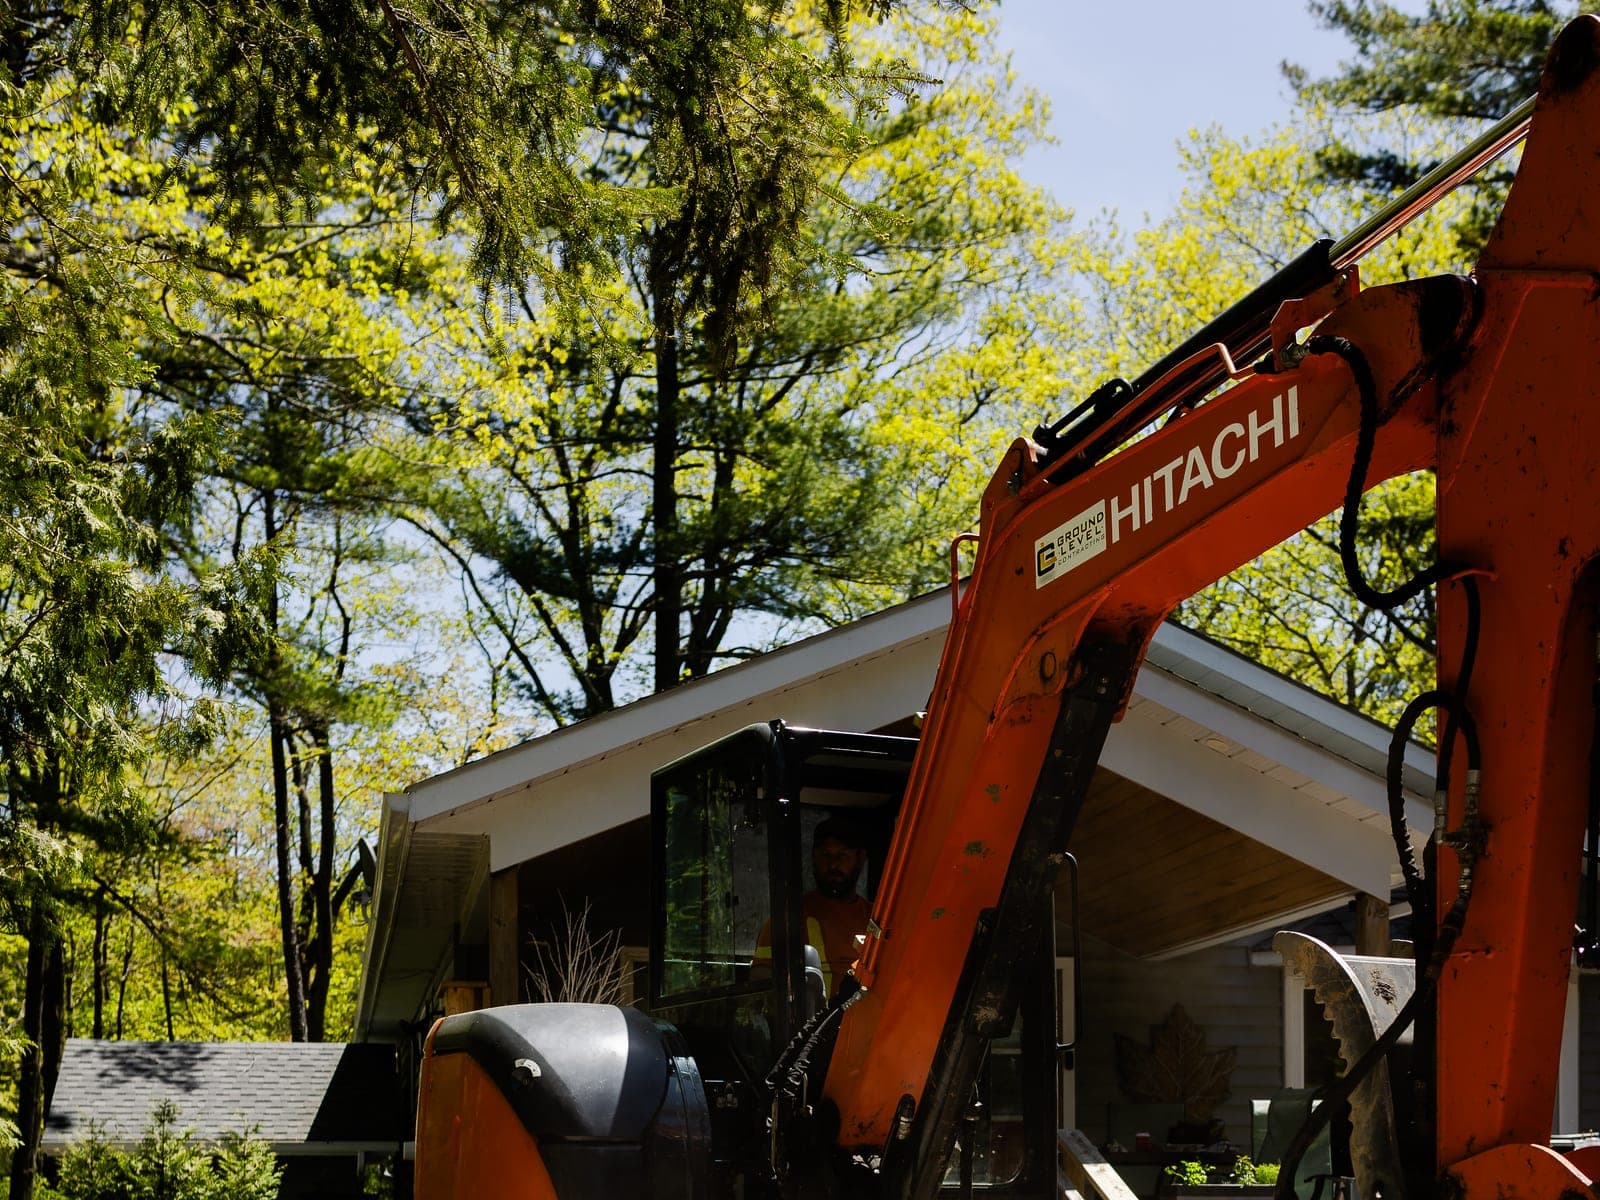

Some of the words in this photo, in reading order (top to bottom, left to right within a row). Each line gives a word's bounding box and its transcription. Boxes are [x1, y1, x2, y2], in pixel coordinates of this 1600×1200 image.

[1110, 385, 1300, 544] HITACHI
[1057, 511, 1104, 547] GROUND
[1061, 525, 1101, 556] LEVEL
[1057, 533, 1105, 566] CONTRACTING
